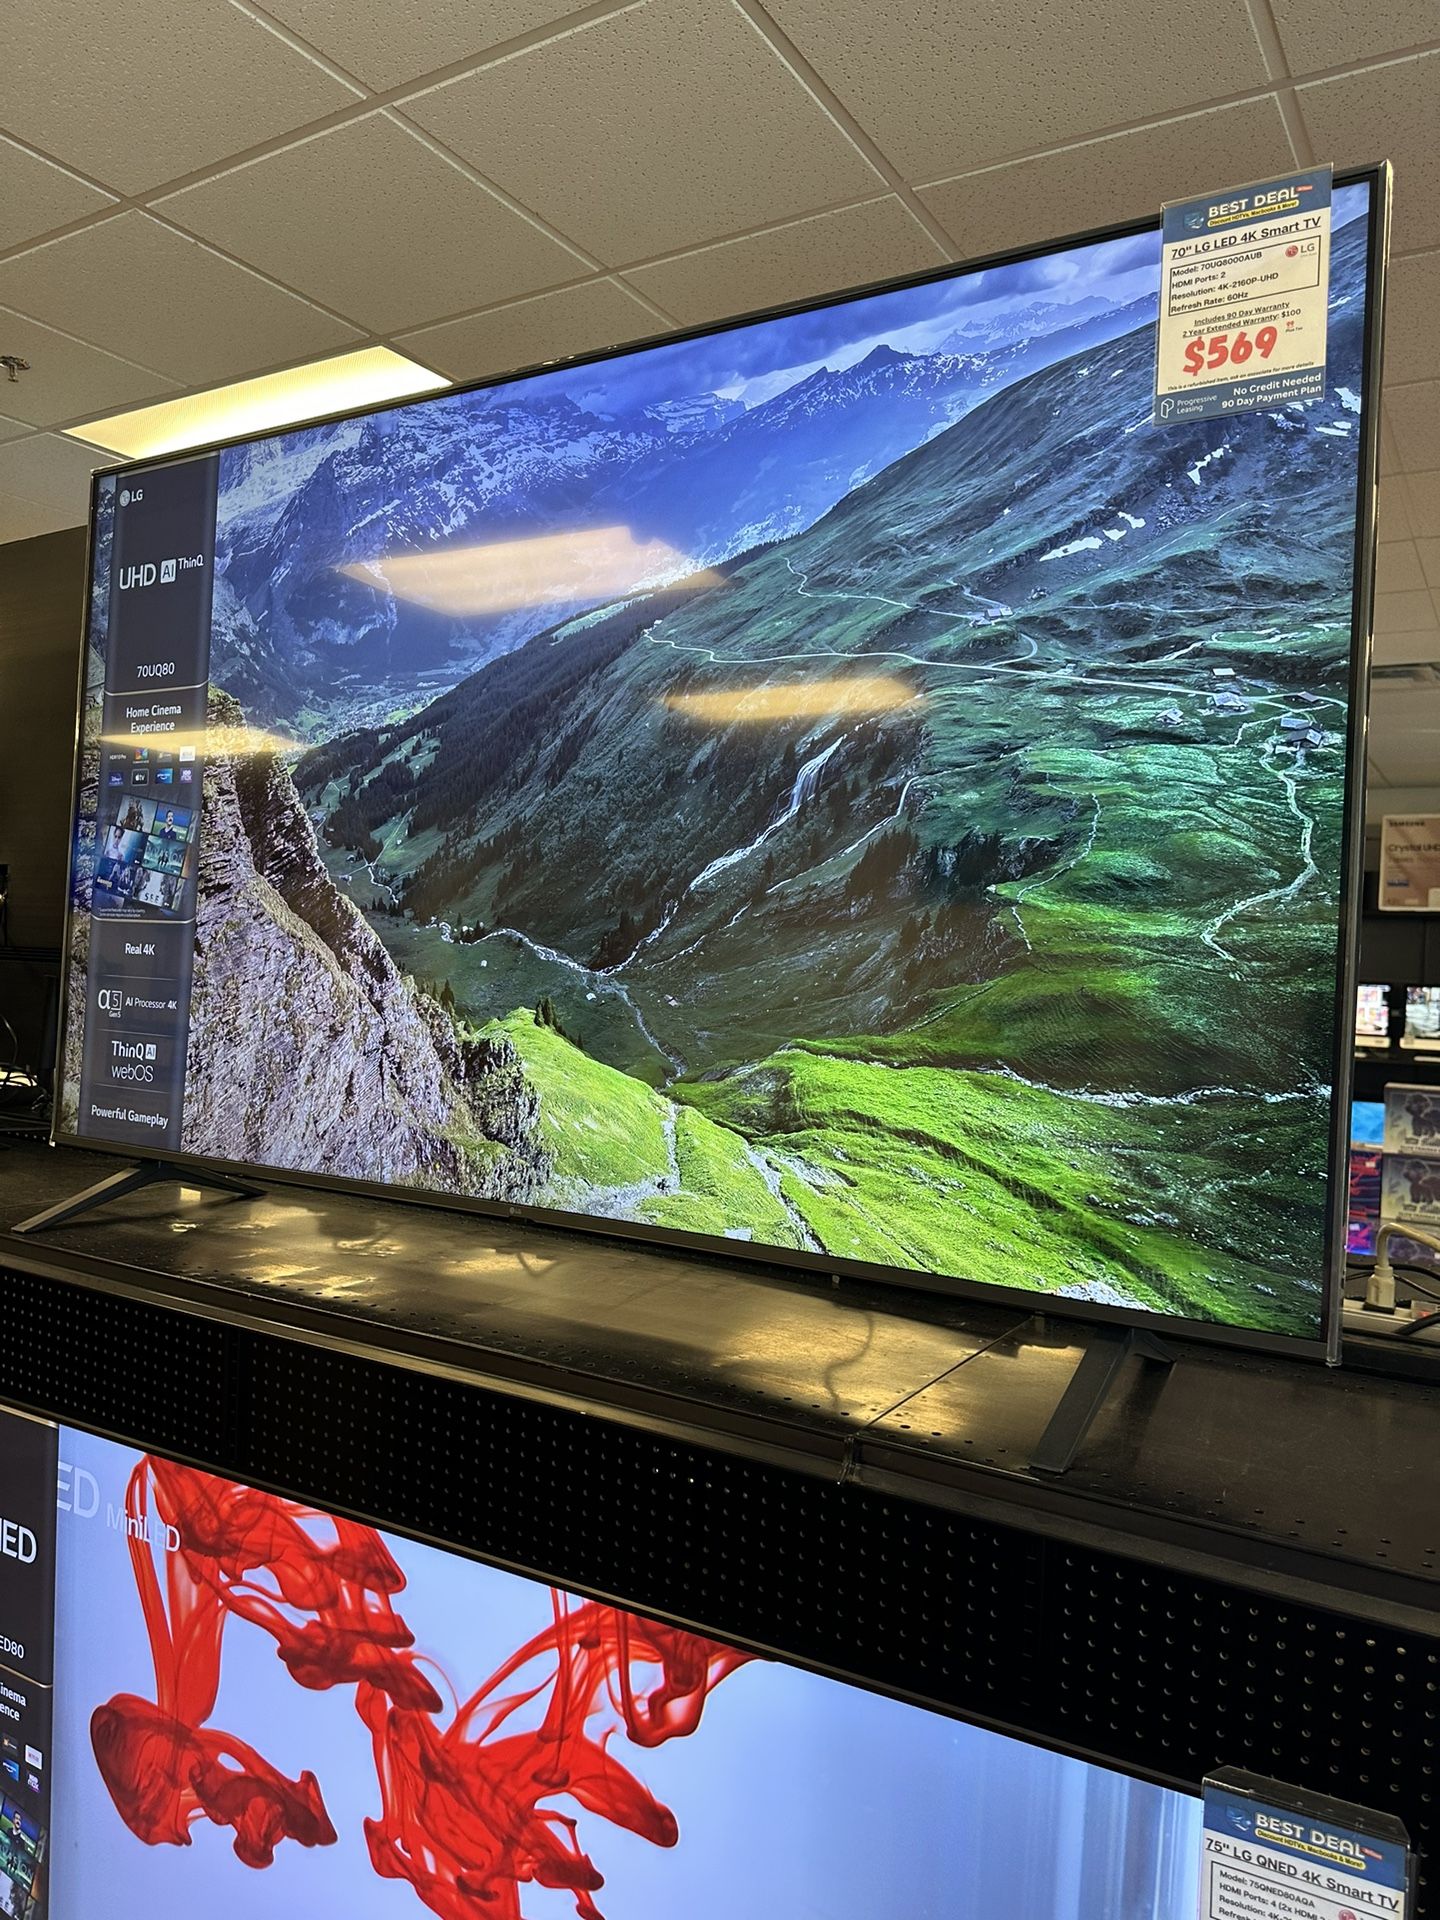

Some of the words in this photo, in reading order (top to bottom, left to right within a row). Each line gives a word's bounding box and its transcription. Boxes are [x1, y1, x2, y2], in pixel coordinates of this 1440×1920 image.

[1208, 198, 1248, 218] BEST
[1254, 186, 1299, 207] DEAL
[1210, 216, 1231, 226] Discount
[1282, 200, 1298, 210] More!
[1172, 245, 1192, 258] 70"
[1195, 241, 1210, 254] LG
[1214, 236, 1237, 250] LED
[1240, 230, 1258, 243] 4K
[1261, 221, 1299, 238] Smart
[1304, 216, 1322, 229] TV
[1300, 242, 1316, 254] LG
[1172, 266, 1198, 277] Model:
[1200, 252, 1262, 271] 70UQ8000AUB
[1172, 280, 1193, 289] HDMI
[1194, 273, 1218, 285] Ports:
[1172, 286, 1216, 301] Resolution:
[1218, 272, 1279, 290] 4K-2160P-UHD
[1170, 301, 1202, 313] Refresh
[1204, 296, 1225, 306] Rate:
[1226, 292, 1248, 302] 60Hz
[1194, 316, 1226, 326] Includes
[1226, 312, 1237, 320] 90
[1238, 309, 1254, 319] Day
[1254, 302, 1290, 316] Warranty
[1188, 326, 1205, 336] Year
[1206, 320, 1242, 333] Extended
[1242, 314, 1280, 328] Warranty:
[1281, 308, 1301, 318] $100
[1182, 326, 1278, 376] $569
[1222, 398, 1235, 408] 90
[1236, 395, 1255, 408] Day
[1256, 389, 1299, 404] Payment
[1300, 384, 1322, 396] Plan
[1233, 386, 1248, 396] No
[1250, 380, 1280, 392] Credit
[1282, 372, 1322, 388] Needed
[1176, 394, 1218, 408] Progressive
[1176, 405, 1204, 417] Leasing
[131, 489, 143, 502] LG
[120, 563, 157, 590] UHD
[162, 562, 176, 581] AI
[178, 554, 204, 570] ThinQ
[136, 662, 175, 678] 70UQ80
[126, 706, 150, 718] Home
[151, 704, 182, 716] Cinema
[130, 720, 175, 736] Experience
[125, 942, 142, 955] Real
[143, 943, 156, 956] 4K
[125, 997, 133, 1006] AI
[134, 998, 166, 1009] Processor
[167, 1000, 177, 1010] 4K
[112, 1040, 144, 1060] ThinQ
[112, 1064, 154, 1082] webOS
[91, 1104, 126, 1120] Powerful
[128, 1110, 169, 1130] Gameplay
[0, 1516, 38, 1564] ED
[1256, 1813, 1305, 1839] BEST
[1311, 1830, 1365, 1859] DEAL
[1257, 1829, 1284, 1844] Discount
[1344, 1857, 1363, 1868] More!
[1206, 1838, 1230, 1852] 75"
[1234, 1846, 1252, 1862] LG
[1256, 1854, 1297, 1876] QNED
[1302, 1870, 1320, 1886] 4K
[1326, 1878, 1374, 1904] Smart
[1378, 1893, 1399, 1910] TV
[1220, 1870, 1248, 1886] Model:
[1249, 1880, 1316, 1908] 75QNED80AQA
[1220, 1882, 1242, 1895] HDMI
[1244, 1890, 1268, 1904] Ports:
[1278, 1902, 1292, 1913] (2x
[1294, 1908, 1318, 1920] HDMI
[1219, 1894, 1266, 1917] Resolution:
